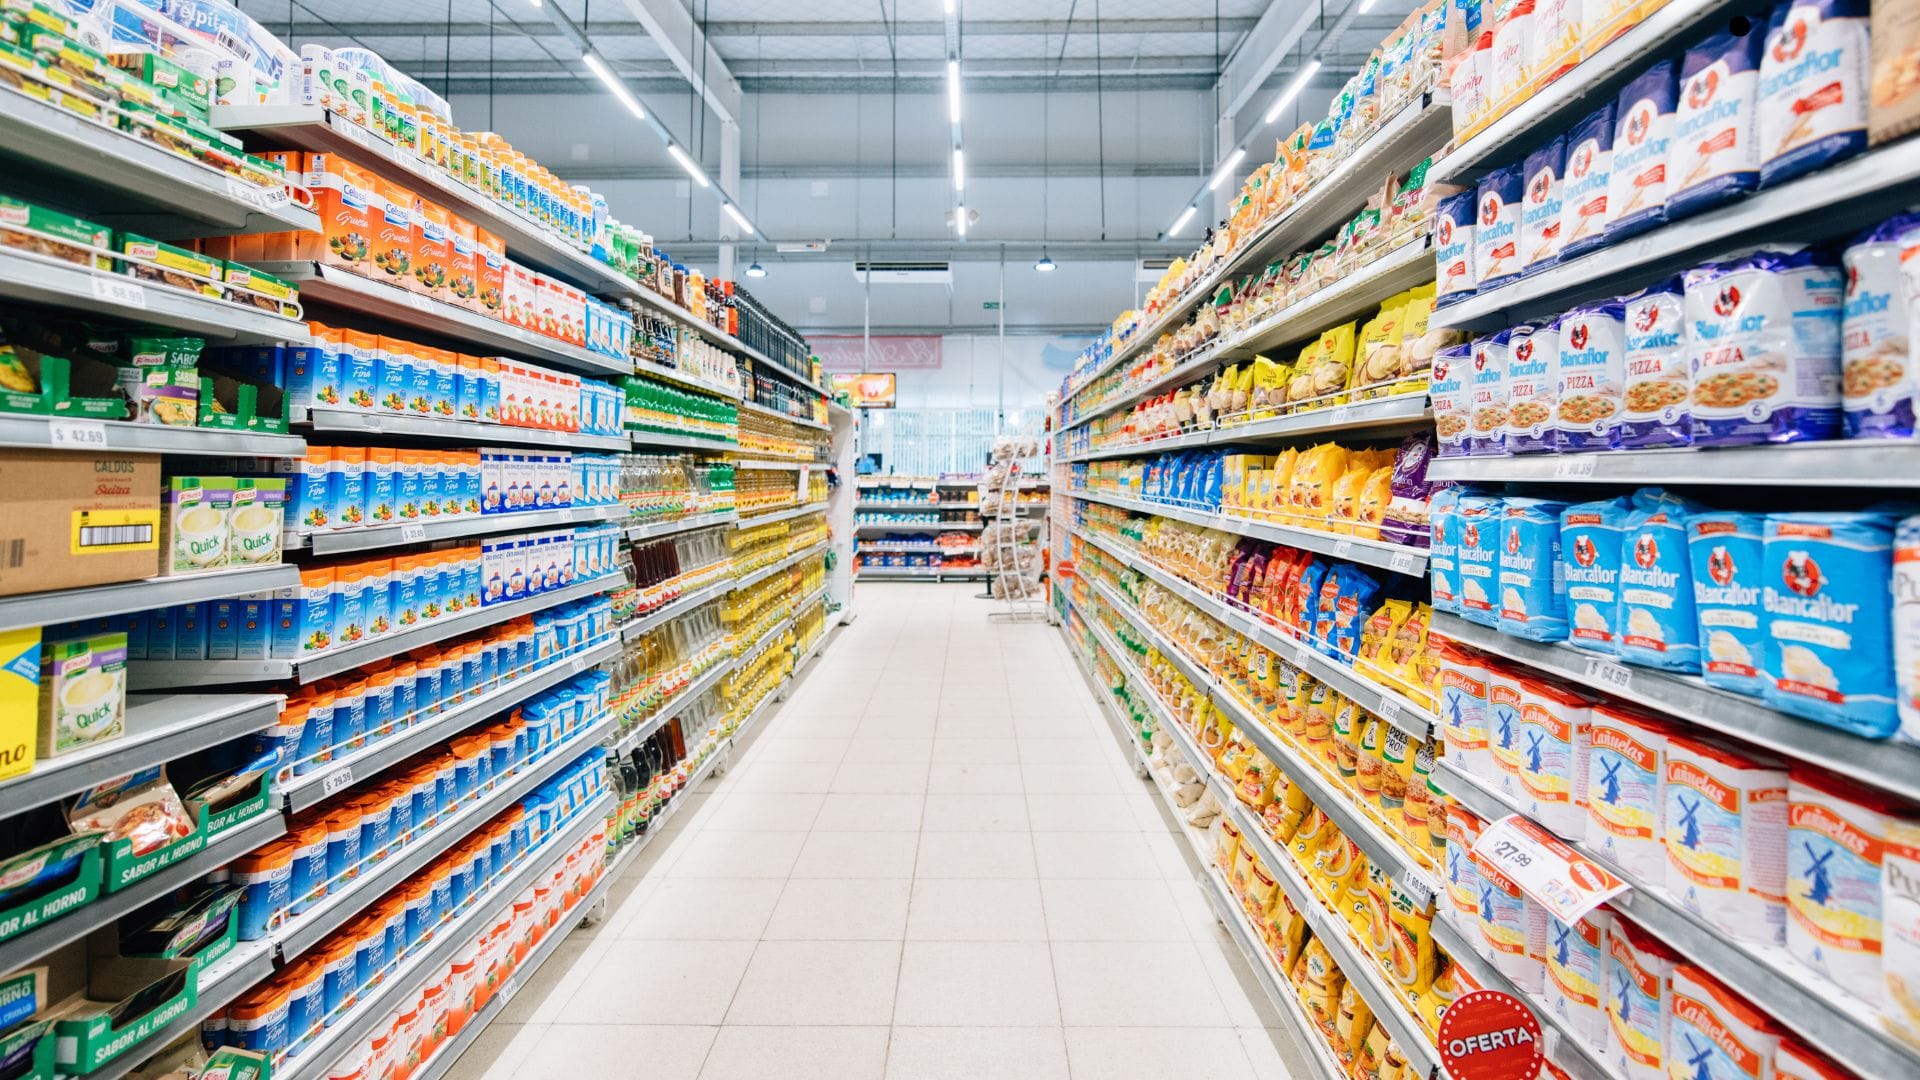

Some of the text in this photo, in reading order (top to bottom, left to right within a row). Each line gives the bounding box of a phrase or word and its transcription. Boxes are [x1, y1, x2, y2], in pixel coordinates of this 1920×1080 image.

[343, 184, 367, 202] Celusal
[336, 211, 369, 228] Gruesa
[385, 203, 409, 221] Celusal
[380, 228, 410, 243] Gruesa
[424, 220, 446, 236] Celusal
[420, 244, 447, 258] Gruesa
[1844, 291, 1891, 318] aflor
[134, 354, 165, 365] Knorr
[1560, 347, 1609, 368] Blancaflor
[1629, 359, 1662, 376] PIZZA
[1430, 378, 1462, 393] ancaflor
[1472, 366, 1502, 385] ncaflor
[1567, 376, 1595, 389] PIZZA
[1512, 385, 1534, 397] PIZZA
[1665, 408, 1672, 419] 6
[1752, 405, 1761, 417] 6
[56, 429, 104, 443] $ 42.69
[1493, 429, 1498, 438] 6
[1534, 426, 1539, 434] 6
[1595, 422, 1603, 431] 6
[94, 461, 135, 474] CALDOS
[191, 535, 220, 555] Quick
[243, 532, 272, 551] Quick
[1564, 562, 1618, 584] Blancaflor
[1621, 563, 1680, 589] Blancaflor
[1695, 581, 1761, 606] Blancaflor
[308, 606, 328, 622] Fina
[343, 600, 361, 615] Fina
[1763, 586, 1860, 624] Blancaflor
[1442, 671, 1478, 693] Cañuelas
[1590, 662, 1629, 687] $ 64.99
[76, 703, 112, 729] Quick
[1522, 705, 1560, 735] Cañuelas
[1592, 729, 1646, 764] Cañuelas
[326, 771, 351, 791] $ 29.39
[1668, 762, 1726, 802] Cañuelas
[208, 798, 264, 833] BOR AL HORNO
[1792, 804, 1869, 854] Cañuelas
[121, 836, 203, 884] SABOR AL HORNO
[1495, 841, 1532, 868] 27.99
[1477, 858, 1513, 891] ñuelas
[267, 883, 289, 904] Fina
[22, 887, 87, 928] AL HORNO
[206, 937, 231, 962] HORNO
[1611, 939, 1647, 987] Cañuelas
[94, 997, 188, 1064] SABOR AL HORNO
[1676, 999, 1746, 1063] Cañuelas
[1449, 1027, 1534, 1058] OFERTA
